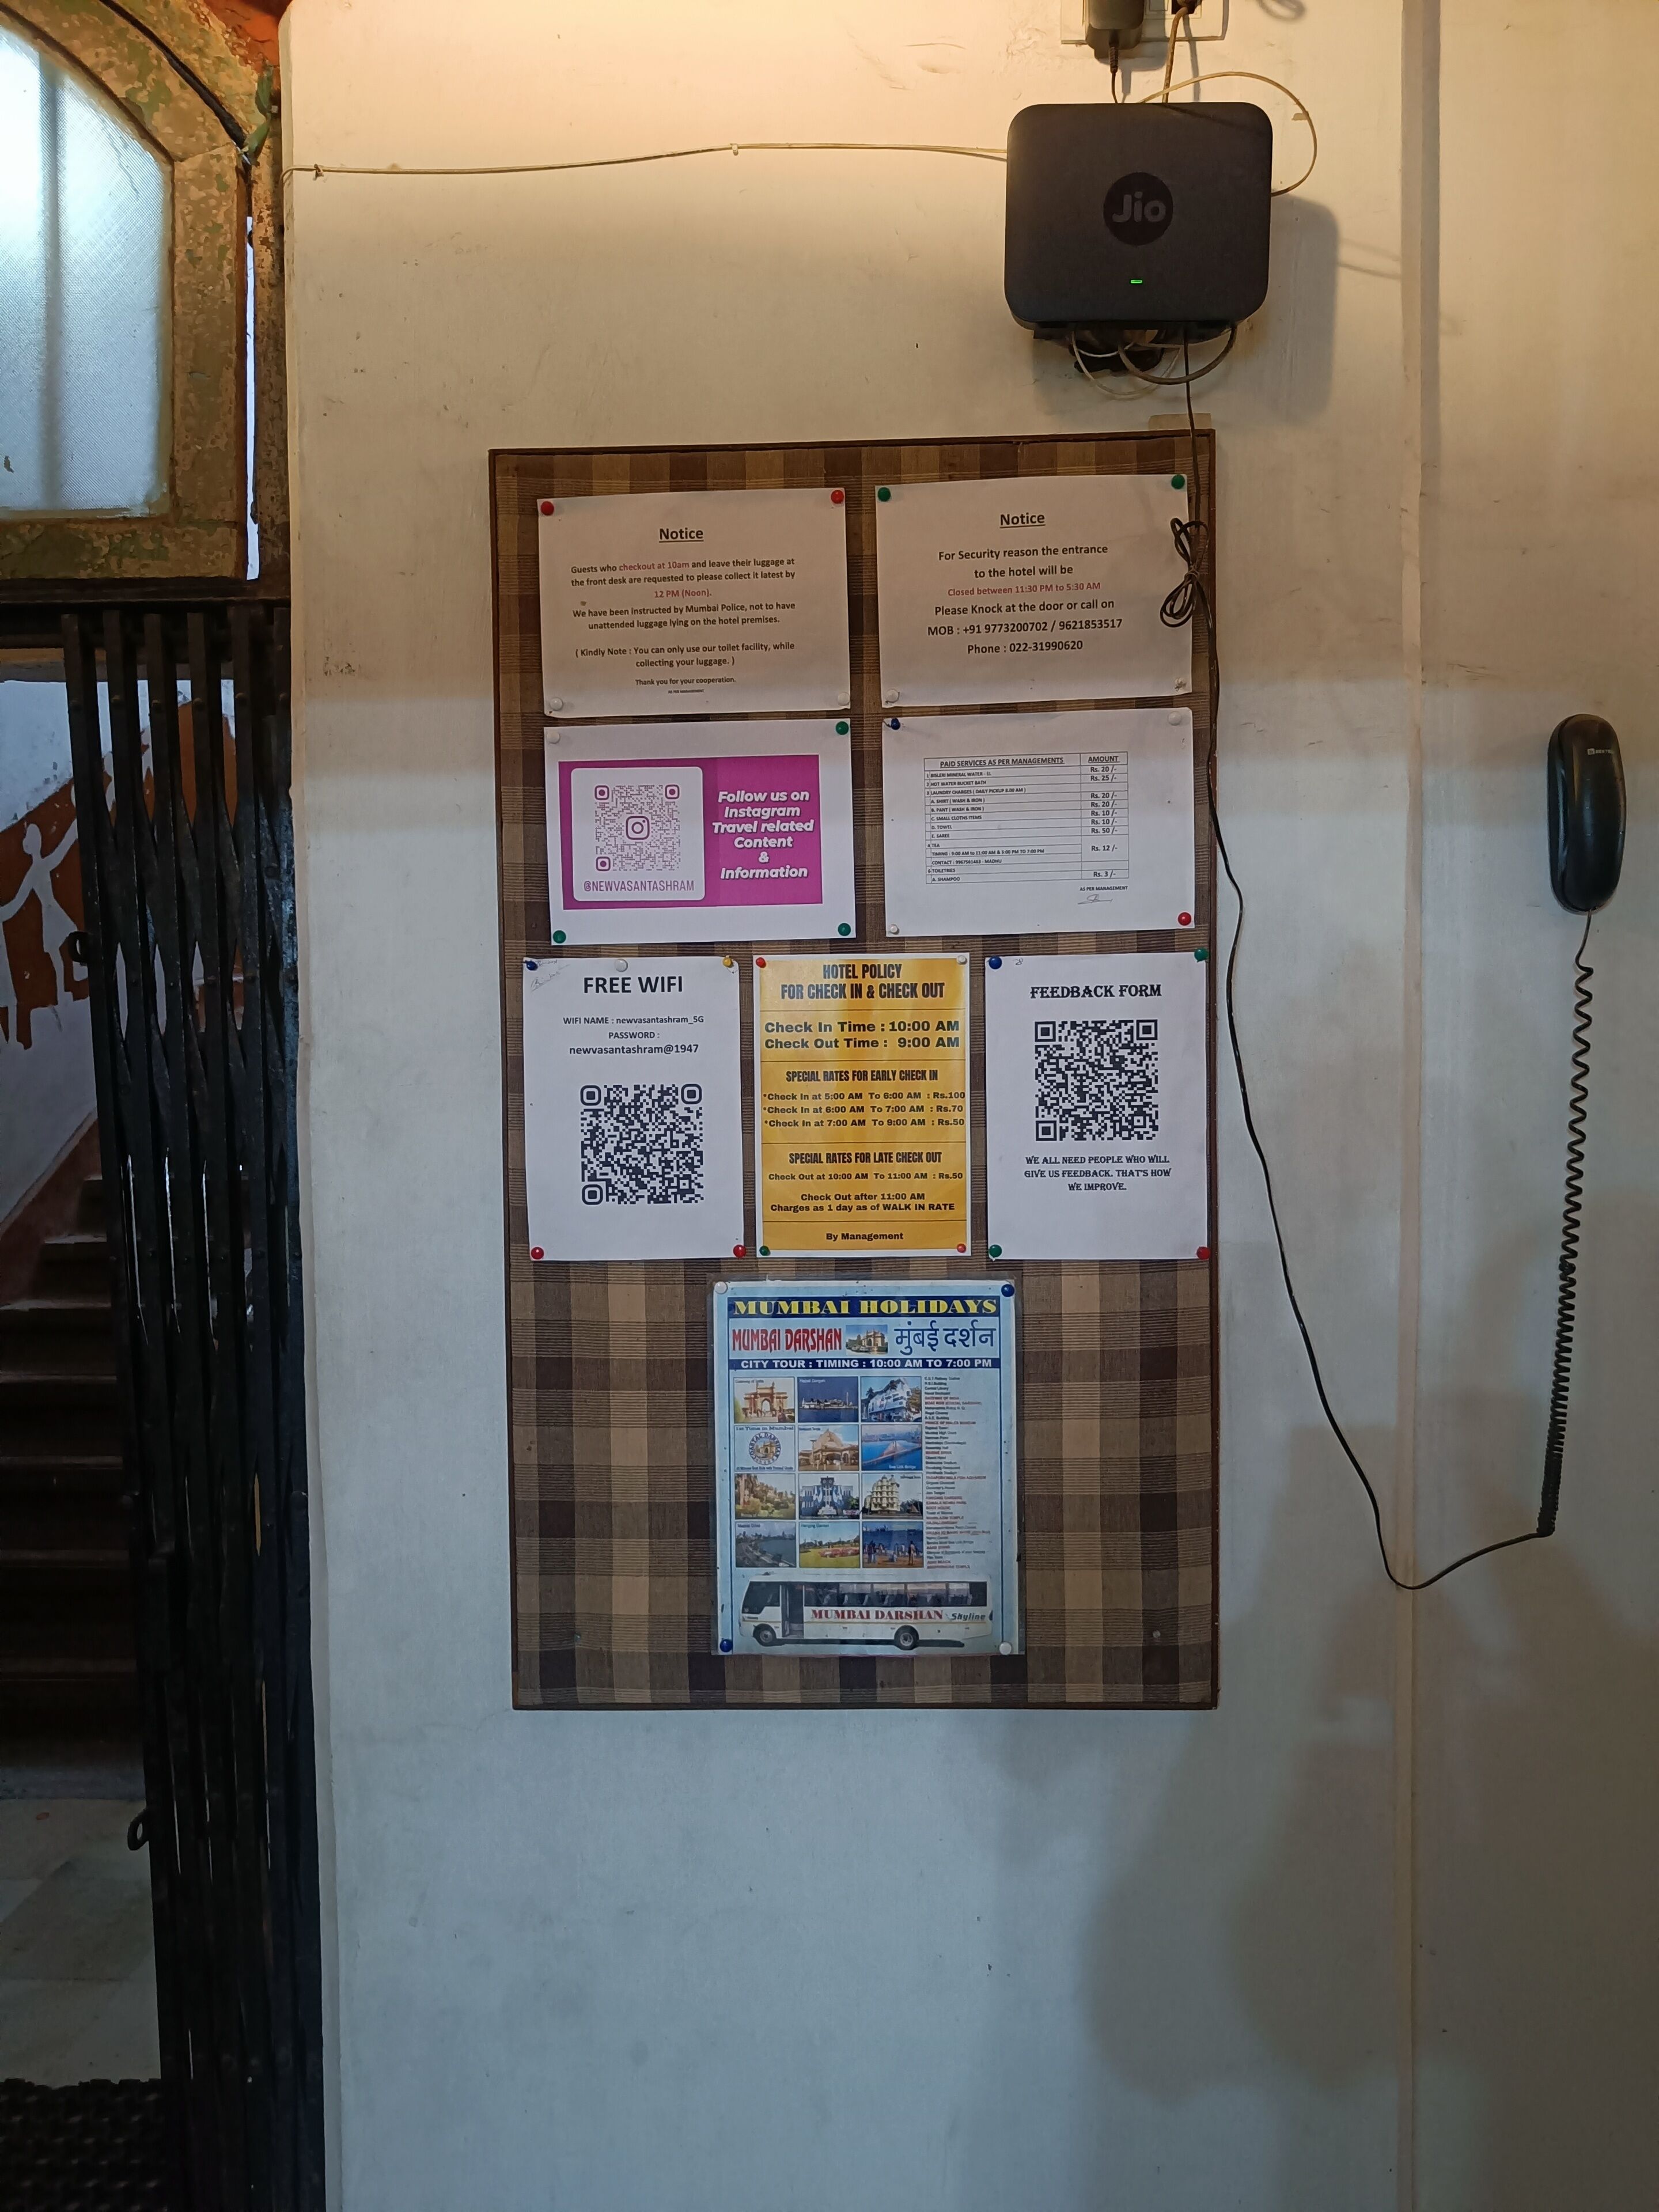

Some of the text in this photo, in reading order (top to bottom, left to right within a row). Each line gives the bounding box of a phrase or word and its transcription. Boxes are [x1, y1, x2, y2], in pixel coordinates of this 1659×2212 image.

[1112, 191, 1166, 222] Jio
[1000, 512, 1046, 527] Notice
[660, 527, 703, 540] Notice
[939, 546, 1108, 560] For Security reason the entrance
[600, 564, 617, 572] who
[619, 563, 655, 571] checkout
[691, 560, 706, 568] and
[732, 559, 751, 567] their
[753, 558, 785, 567] luggage
[974, 565, 1073, 578] to the hotel will be
[571, 578, 584, 586] the
[608, 577, 627, 585] desk
[643, 574, 684, 584] requested
[696, 573, 722, 582] please
[725, 572, 751, 580] collect
[785, 570, 795, 579] by
[681, 589, 711, 599] (Noon).
[948, 588, 975, 596] Closed
[1016, 585, 1037, 593] 11:30
[1040, 584, 1053, 592] PM
[928, 626, 954, 635] MOB
[963, 624, 982, 634] +91
[984, 622, 1048, 633] 9773200702
[1051, 620, 1056, 632] /
[1059, 619, 1122, 630] 9621853517
[968, 644, 1000, 654] Phone
[1009, 641, 1083, 652] 022-31990620
[696, 676, 736, 684] cooperation.
[1011, 757, 1064, 765] MANAGEMENTS
[718, 790, 809, 802] Follow us on
[724, 806, 800, 819] Instagram
[712, 819, 814, 834] Travel related
[734, 836, 793, 848] Content
[759, 851, 769, 862] &
[721, 866, 808, 879] Information
[584, 880, 694, 892] @NEWVASANTASHRAM
[823, 964, 902, 979] HOTEL POLICY
[584, 976, 682, 993] FREE WIFI
[781, 982, 945, 999] FOR CHECK IN & CHECK OUT
[1030, 984, 1162, 999] FEEDBACK FORM
[616, 1016, 704, 1024] newvasantashram_5G
[765, 1021, 813, 1033] Check
[819, 1022, 832, 1032] In
[838, 1021, 876, 1032] Time
[889, 1021, 930, 1032] 10:00
[935, 1021, 959, 1031] AM
[765, 1038, 809, 1048] Check
[814, 1038, 839, 1048] Out
[843, 1037, 879, 1048] Time
[898, 1037, 930, 1048] 9:00
[935, 1037, 959, 1047] AM
[570, 1044, 699, 1054] newvasantashram@1947
[1025, 1156, 1040, 1164] WE
[1125, 1154, 1146, 1163] WHO
[1147, 1154, 1170, 1163] WILL
[1024, 1169, 1046, 1177] GIVE
[1062, 1169, 1113, 1177] FEEDBACK.
[1150, 1168, 1172, 1177] HOW
[1067, 1182, 1127, 1191] WE IMPROVE.
[826, 1233, 903, 1241] By Management
[734, 1300, 996, 1315] MUMBAI HOLIDAYS
[732, 1328, 842, 1353] MUMBAI DARSHAN
[894, 1320, 997, 1355] मुंबई दर्शन
[741, 1360, 768, 1369] CITY
[772, 1359, 806, 1369] TOUR
[816, 1359, 861, 1368] TIMING
[869, 1359, 901, 1368] 10:00
[904, 1359, 923, 1368] AM
[926, 1359, 942, 1368] TO
[946, 1359, 971, 1368] 7:00
[974, 1359, 992, 1368] PM
[812, 1609, 943, 1620] MUMBAI DARSHAN
[951, 1612, 986, 1622] Skyline
